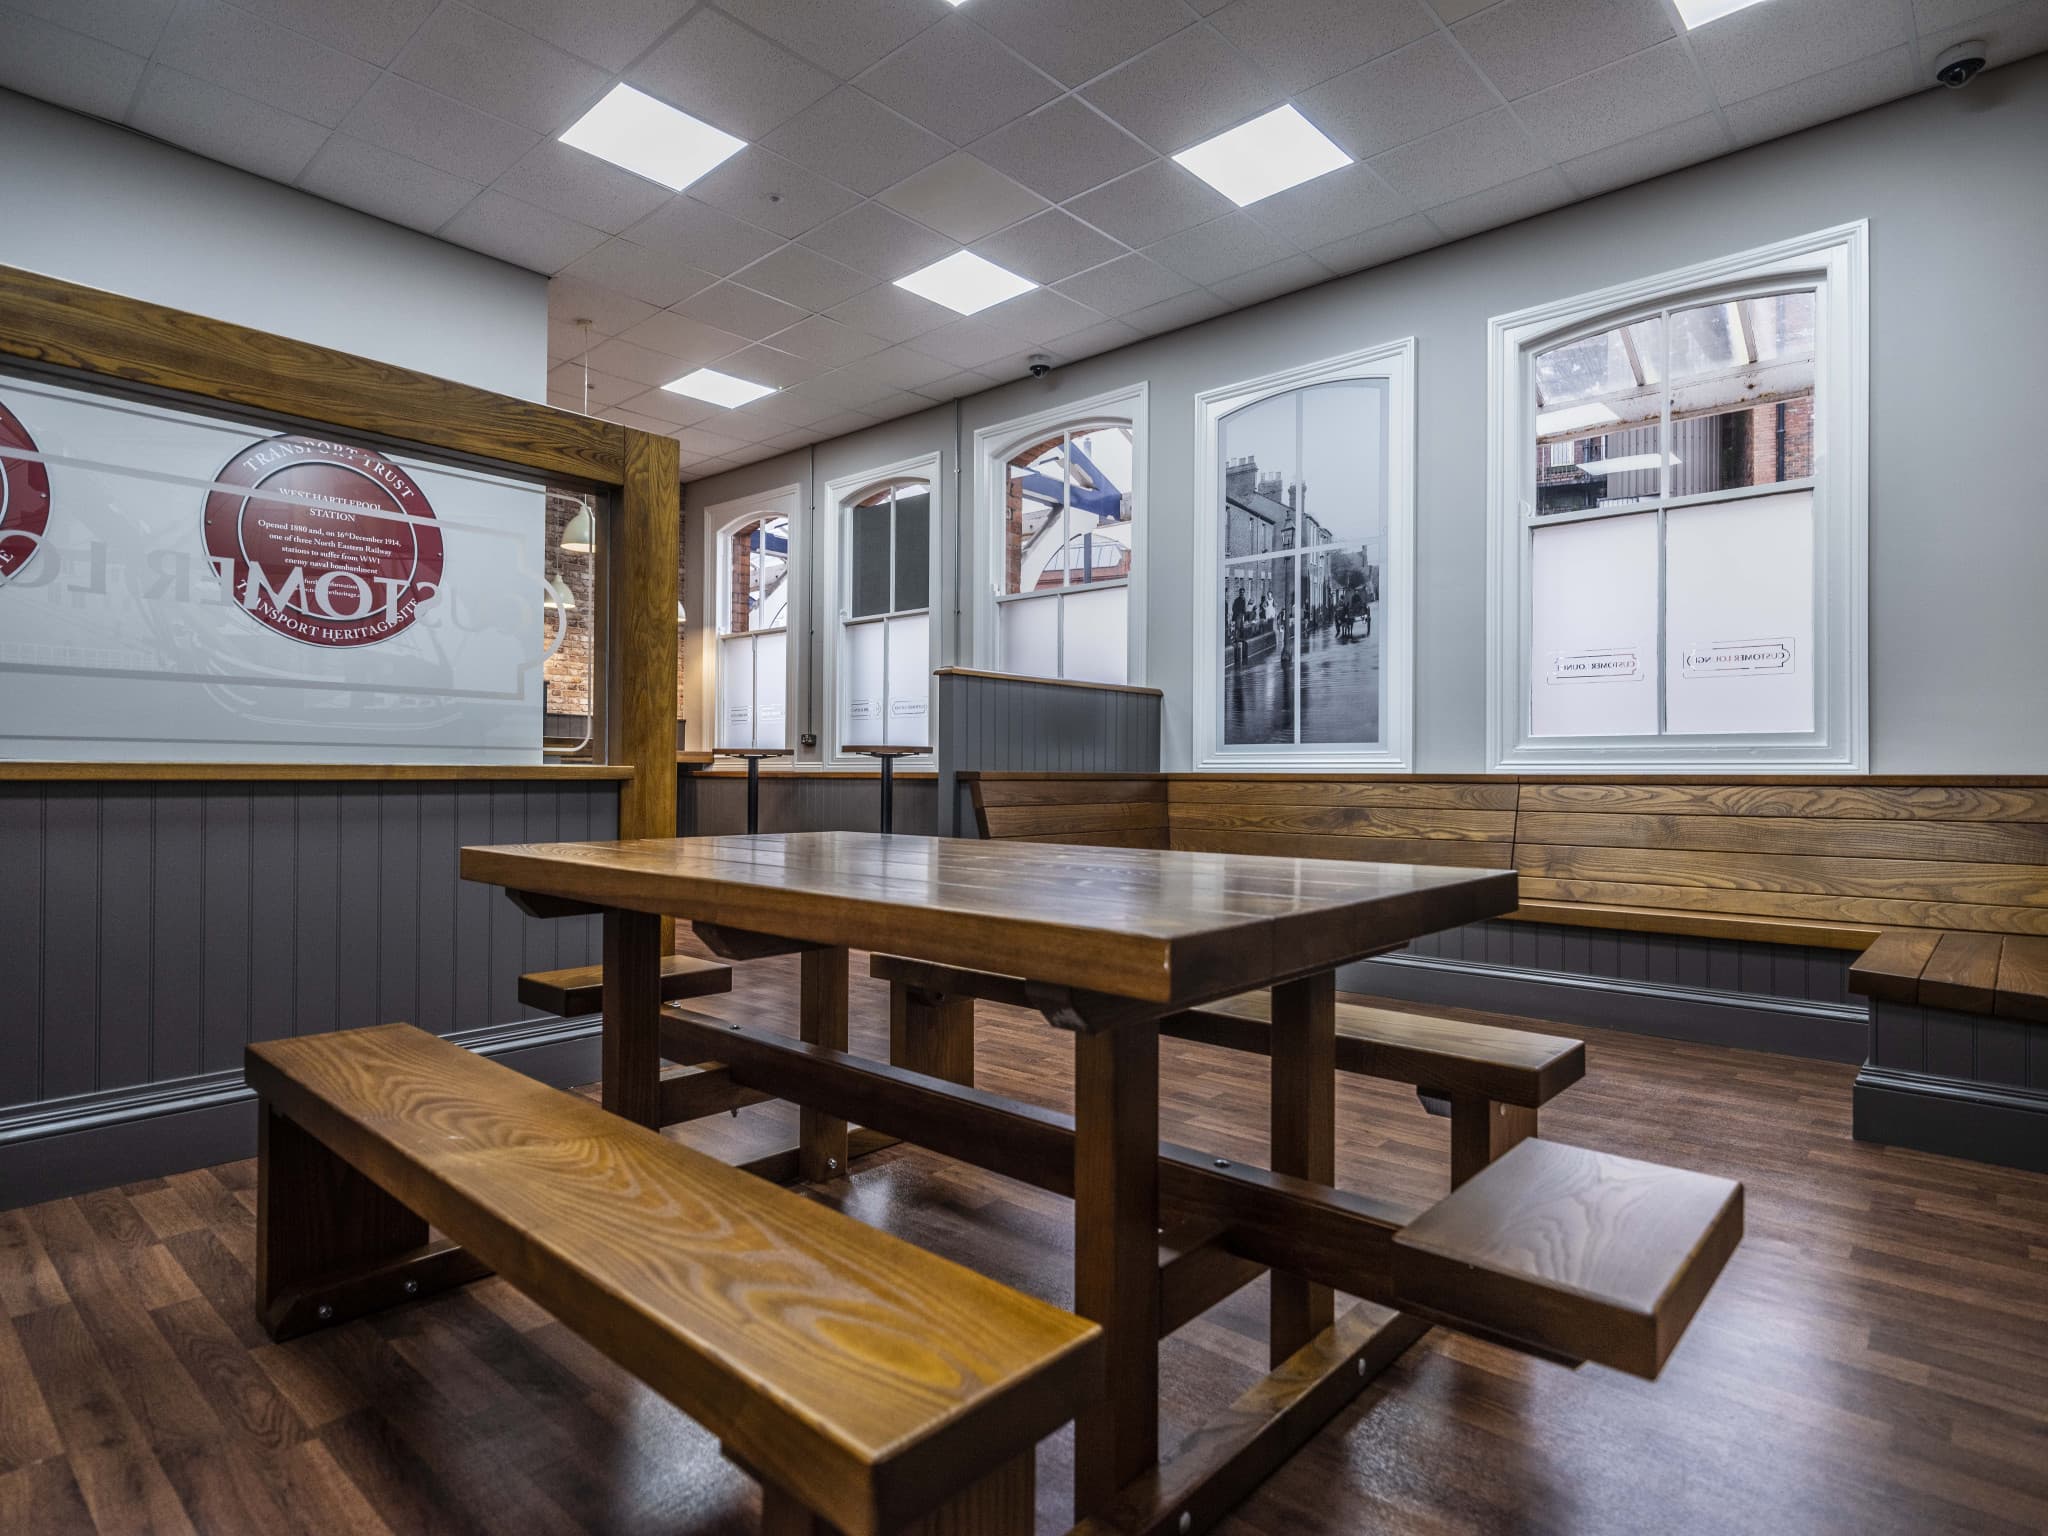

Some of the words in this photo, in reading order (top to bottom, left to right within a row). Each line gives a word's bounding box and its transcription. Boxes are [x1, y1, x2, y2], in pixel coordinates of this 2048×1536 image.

[242, 440, 359, 471] TRANSPORT
[362, 454, 414, 499] TRUST
[279, 487, 310, 499] WEST
[309, 508, 356, 522] STATION
[258, 519, 289, 531] Opened
[290, 524, 308, 533] 1880
[308, 527, 324, 536] and,
[349, 532, 383, 544] December
[384, 538, 401, 548] 1914,
[269, 533, 282, 541] one
[284, 534, 293, 542] of
[293, 535, 312, 545] three
[314, 538, 336, 548] North
[337, 542, 364, 552] Eastern
[365, 546, 392, 557] Railway
[281, 546, 310, 555] stations
[311, 548, 319, 556] to
[320, 550, 340, 559] suffer
[341, 553, 358, 562] from
[284, 557, 307, 567] enemy
[309, 560, 329, 569] naval
[330, 563, 378, 575] bombardment
[236, 579, 319, 637] TNSPORT
